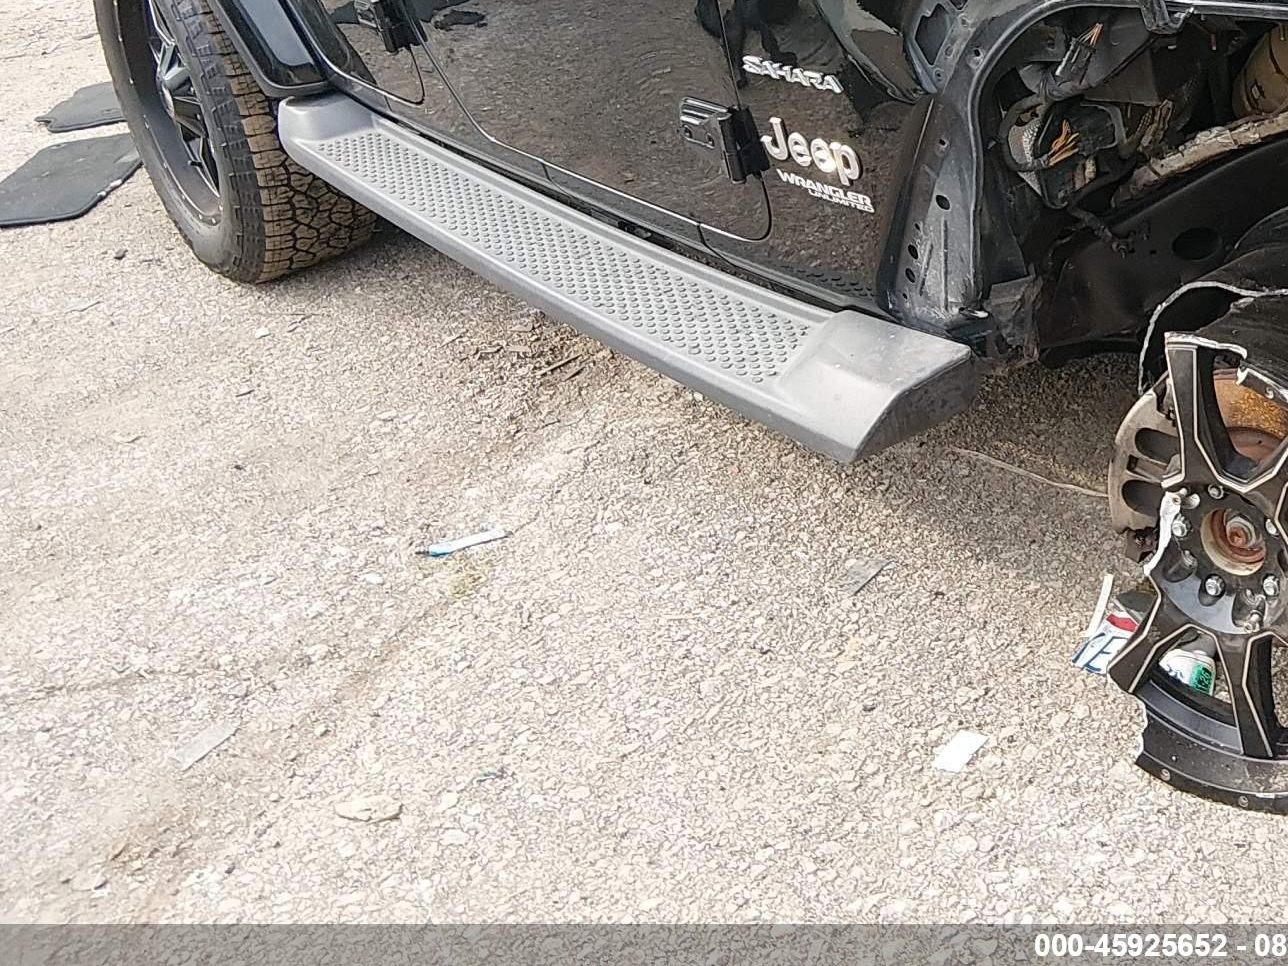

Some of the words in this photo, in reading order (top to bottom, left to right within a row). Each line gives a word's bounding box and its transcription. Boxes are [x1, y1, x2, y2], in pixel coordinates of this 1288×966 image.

[742, 55, 845, 94] SAHARA
[760, 116, 862, 187] Jeep
[776, 168, 873, 206] WRANGLER
[807, 187, 876, 214] UNLIMITED
